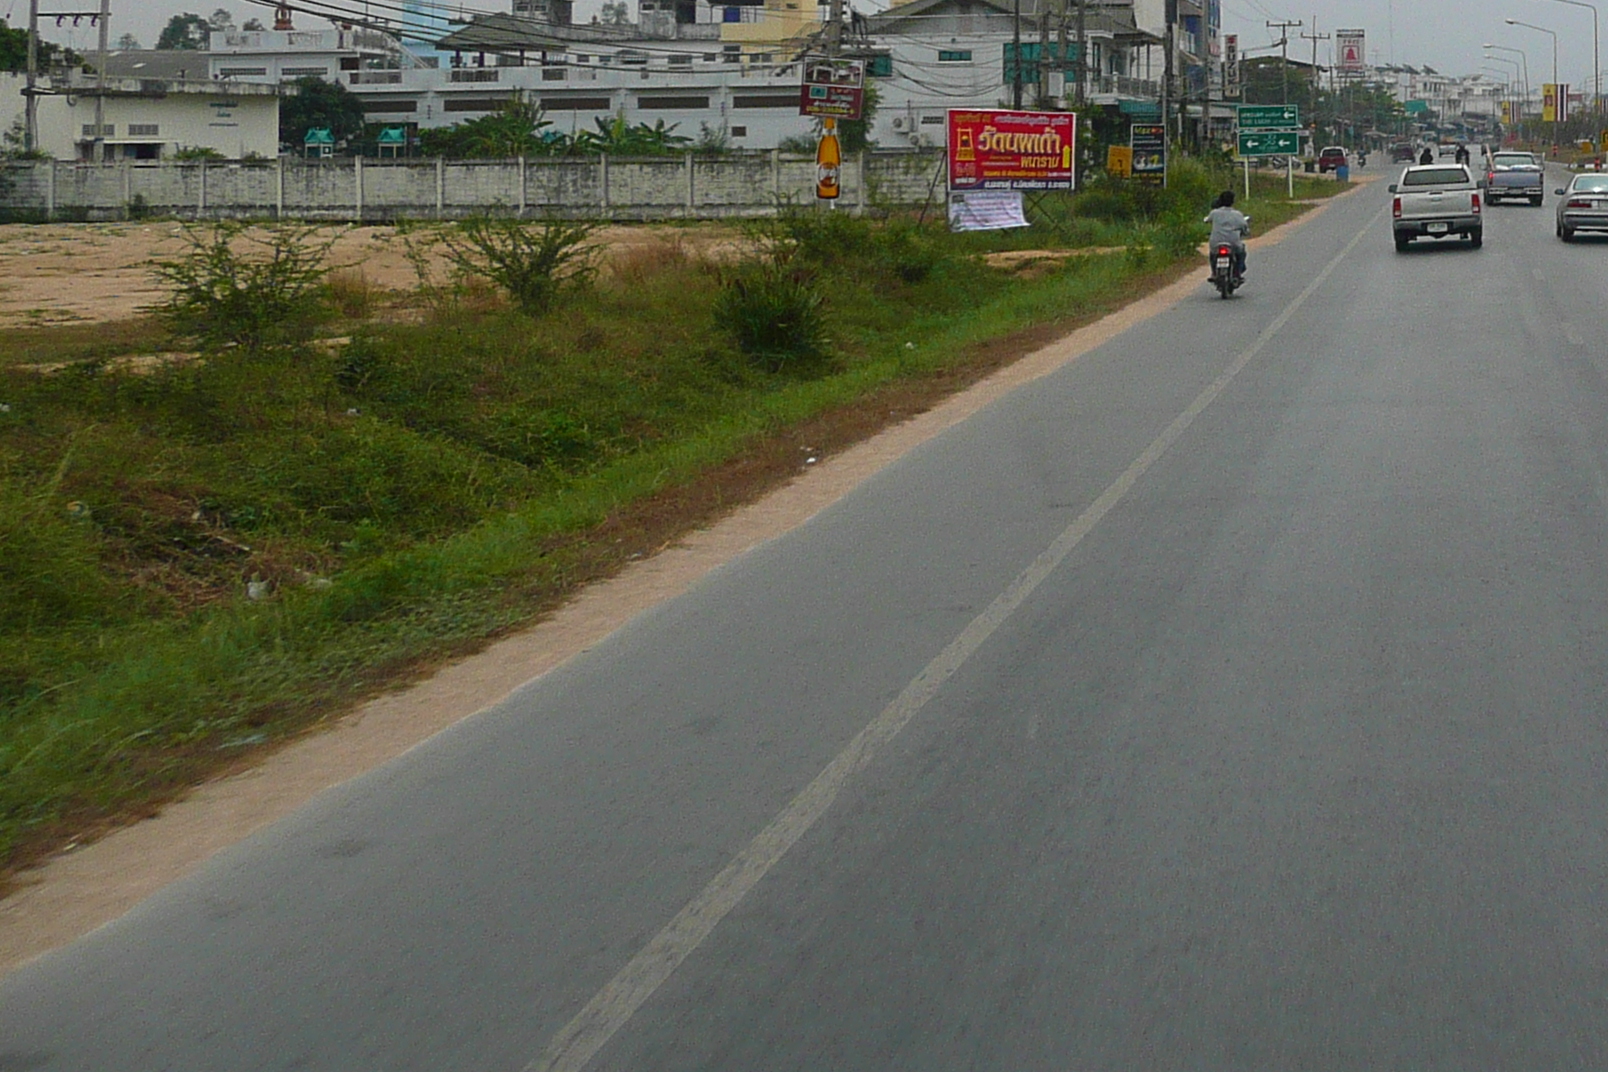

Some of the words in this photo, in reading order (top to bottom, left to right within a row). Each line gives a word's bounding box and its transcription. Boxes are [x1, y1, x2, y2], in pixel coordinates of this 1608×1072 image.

[1227, 45, 1237, 95] SUZUKI
[978, 125, 1060, 154] วัดนพเก้า
